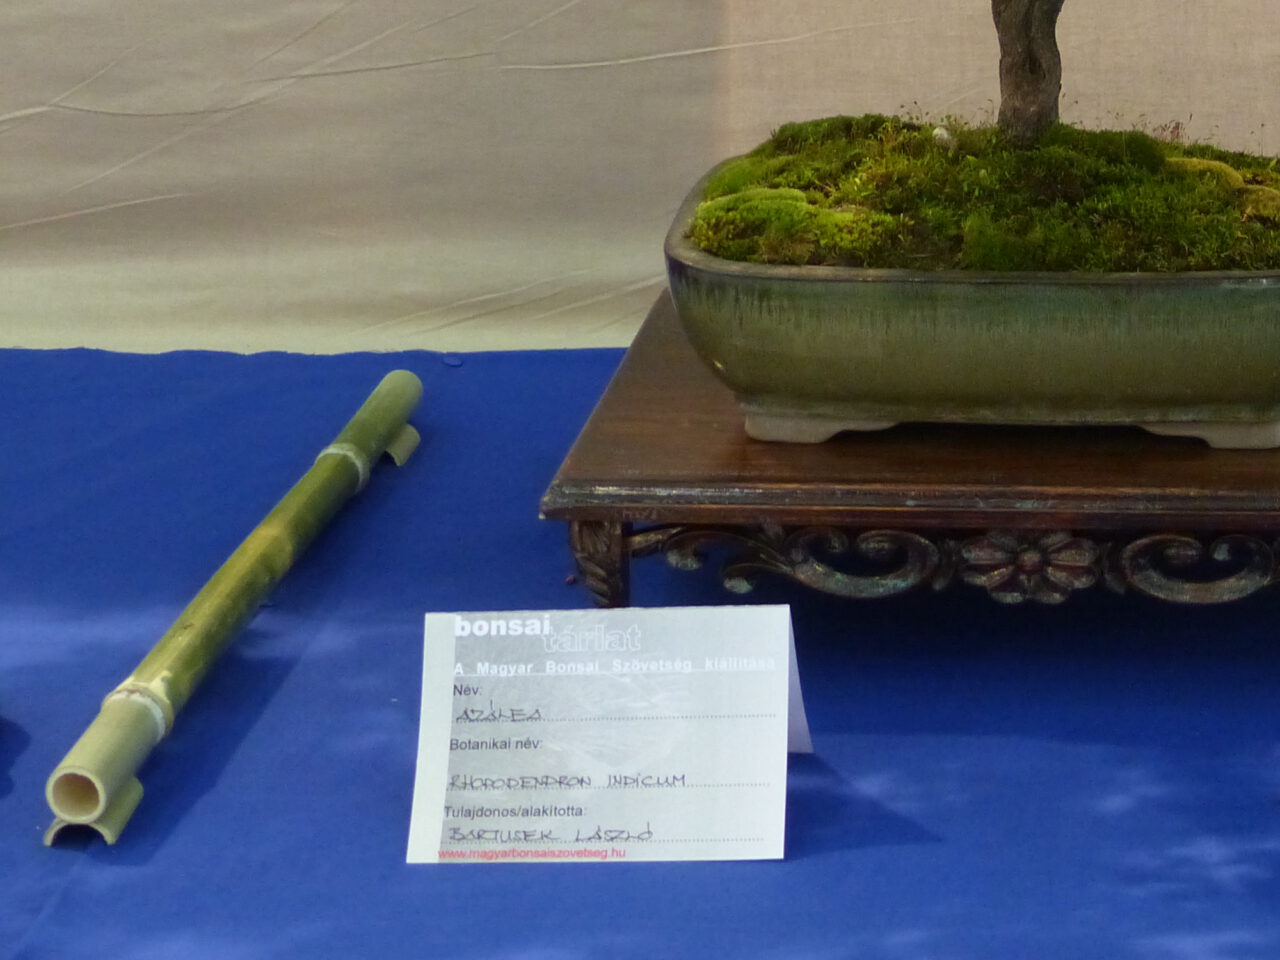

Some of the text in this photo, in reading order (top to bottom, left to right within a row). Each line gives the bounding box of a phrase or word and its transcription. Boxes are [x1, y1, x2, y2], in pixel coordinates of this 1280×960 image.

[455, 615, 550, 637] bonsai
[542, 624, 641, 653] tárlat
[454, 666, 464, 675] A
[477, 662, 534, 677] Magyar
[546, 660, 599, 673] Bonsai
[612, 658, 692, 673] Szövetség
[453, 684, 482, 697] Név:
[450, 737, 543, 751] Botanikai név:
[438, 848, 626, 861] www.magyarbonsaiszovetseg.hu
